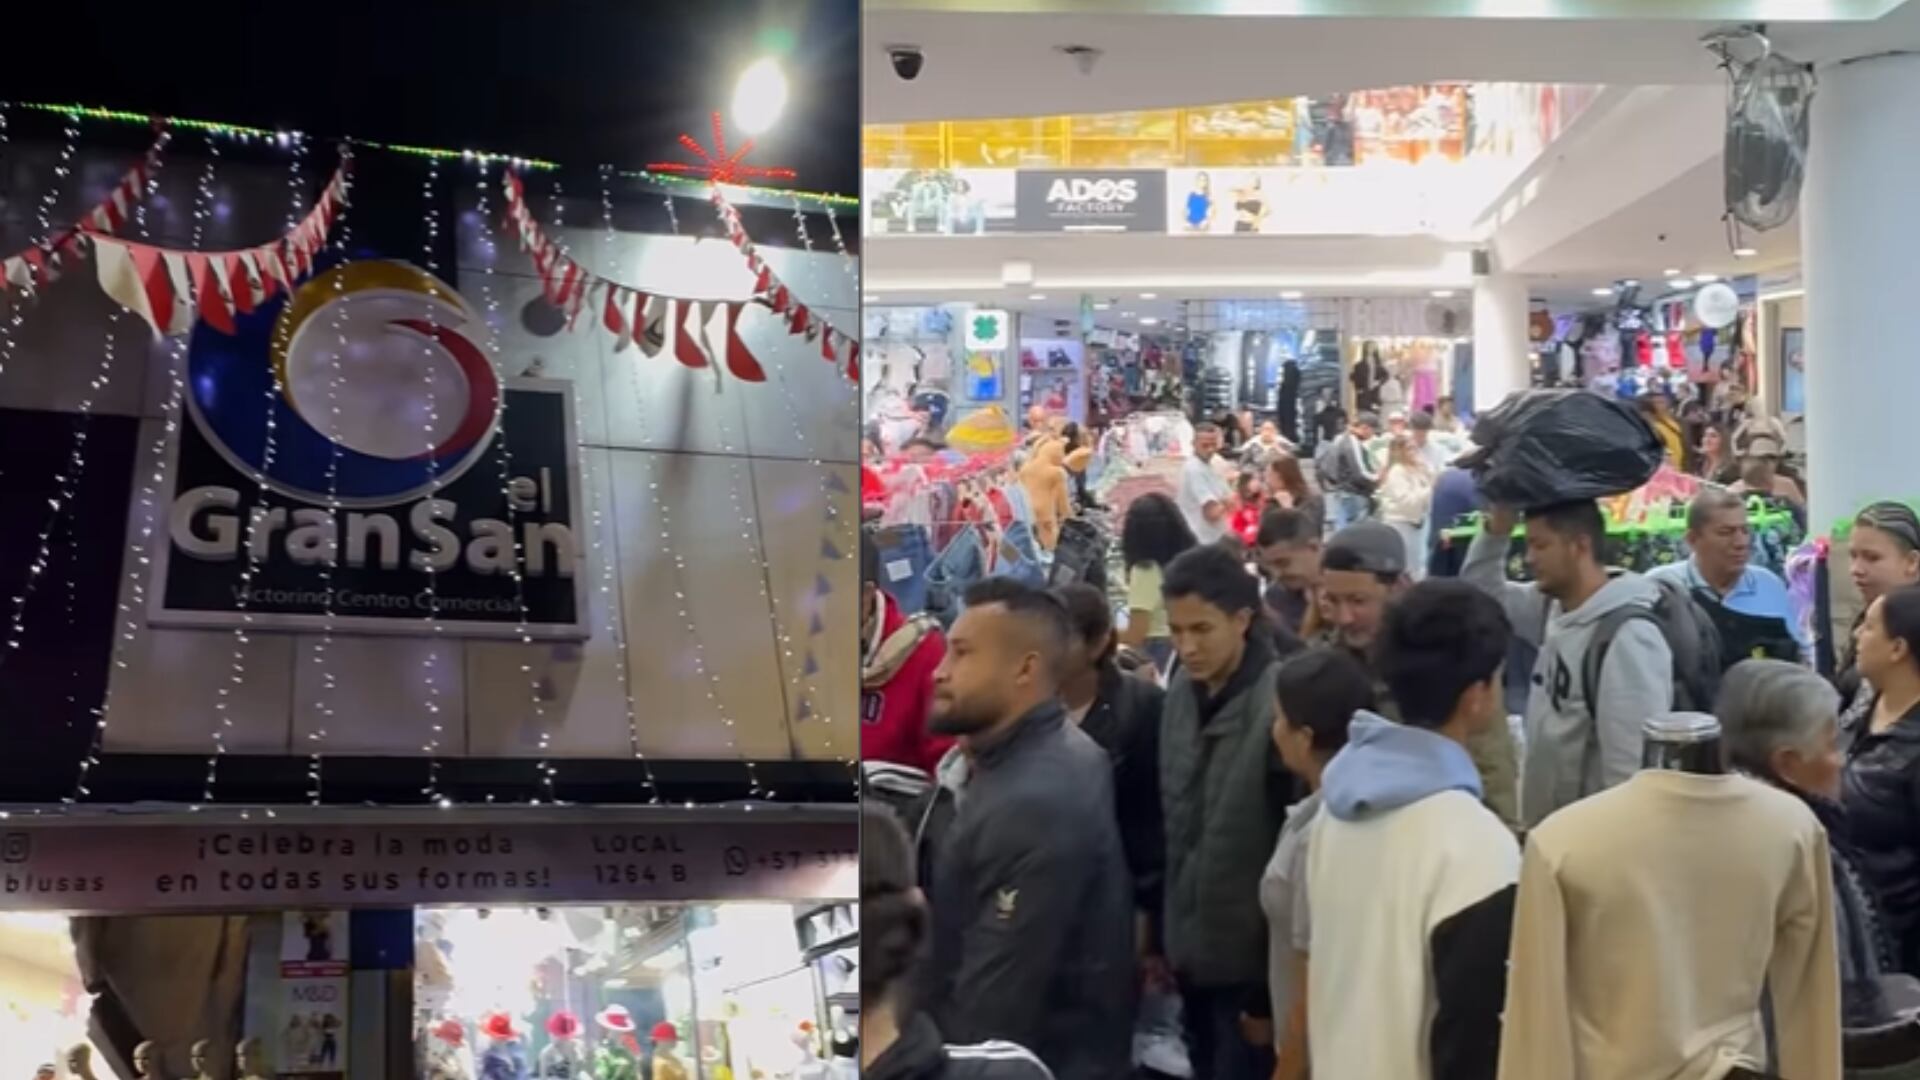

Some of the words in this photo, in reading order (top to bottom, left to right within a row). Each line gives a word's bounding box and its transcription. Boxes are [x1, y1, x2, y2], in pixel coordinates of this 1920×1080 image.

[509, 467, 552, 513] el
[168, 485, 575, 578] GranSan
[337, 590, 410, 609] Centro
[414, 592, 523, 614] Comercial
[199, 833, 355, 860] ¡Celebra
[375, 834, 403, 856] la
[424, 833, 514, 856] moda
[593, 834, 685, 854] LOCAL
[5, 873, 105, 893] blusas
[156, 875, 198, 893] en
[220, 868, 322, 891] todas
[343, 873, 400, 891] sus
[418, 866, 551, 890] formas!
[595, 864, 657, 885] 1264
[672, 864, 688, 884] B
